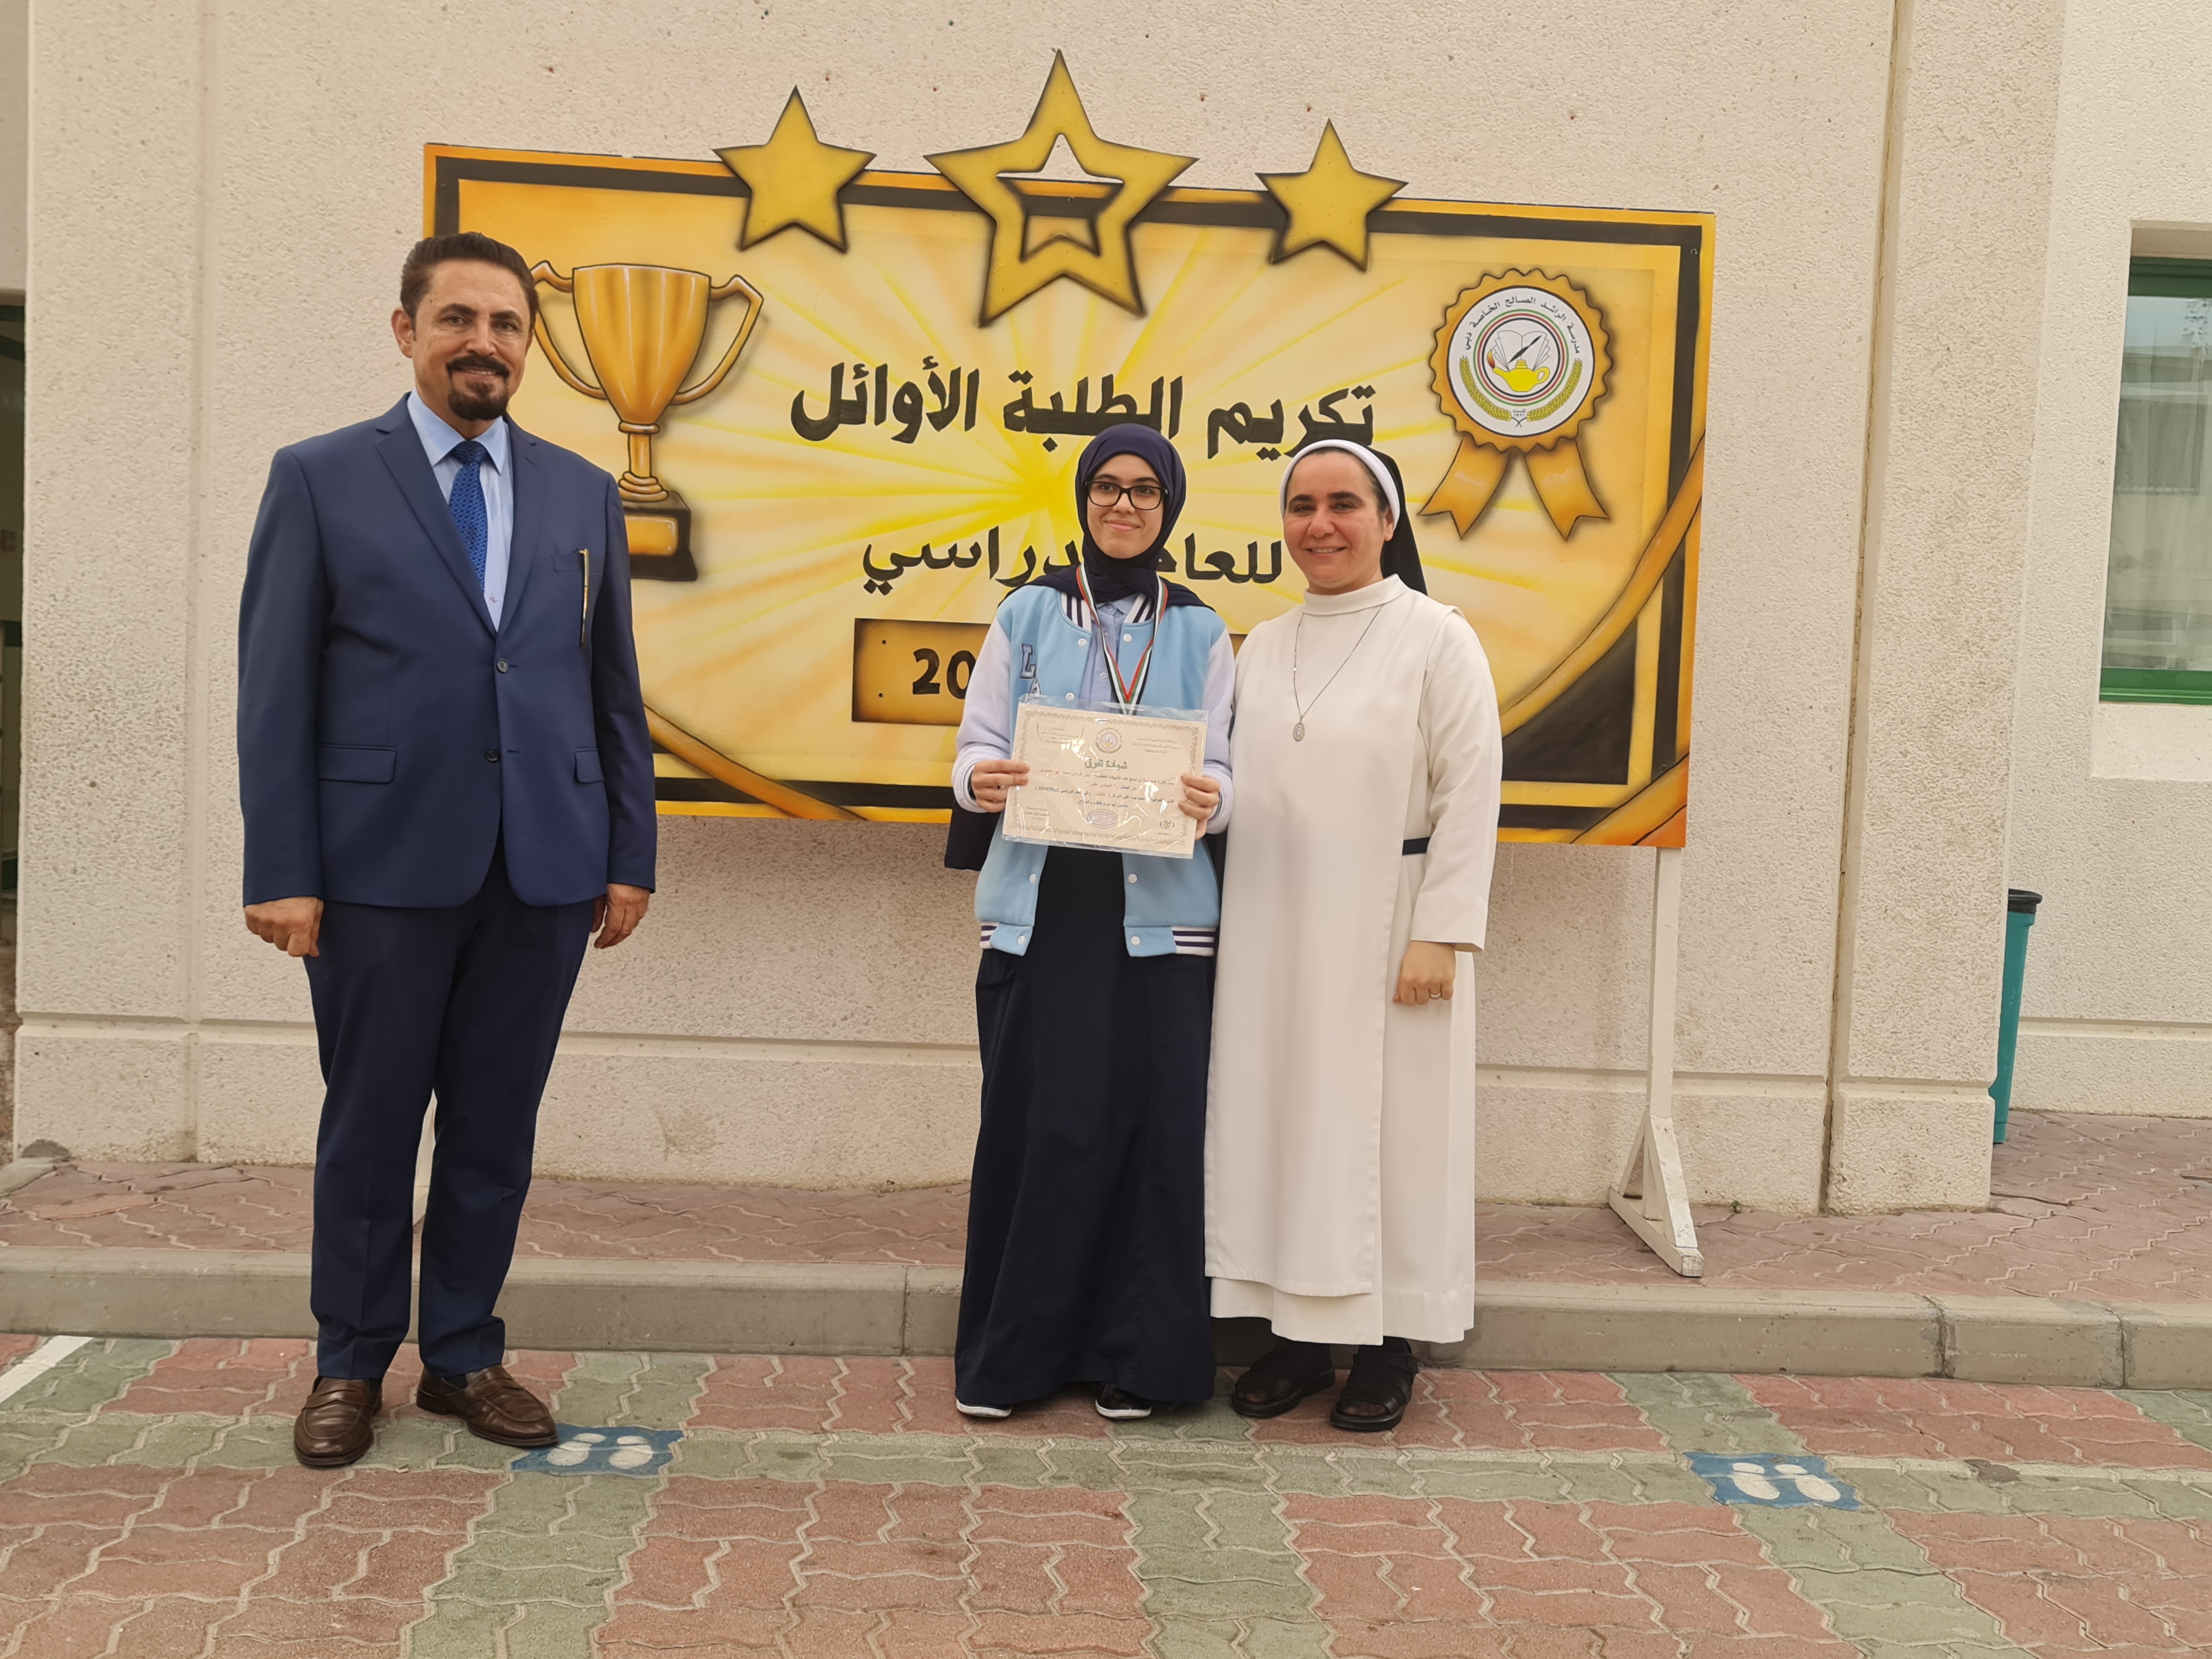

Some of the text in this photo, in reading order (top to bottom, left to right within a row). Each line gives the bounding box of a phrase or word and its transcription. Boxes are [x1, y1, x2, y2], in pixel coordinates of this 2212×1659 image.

[1469, 301, 1500, 328] الخاصة
[1505, 296, 1536, 307] الصالح
[1541, 302, 1567, 321] الراشد
[1567, 322, 1580, 354] مدرسة
[791, 355, 1376, 461] تكريم الطلبة الأوائل
[863, 525, 1082, 596] دراسي
[1106, 760, 1128, 771] شهادة
